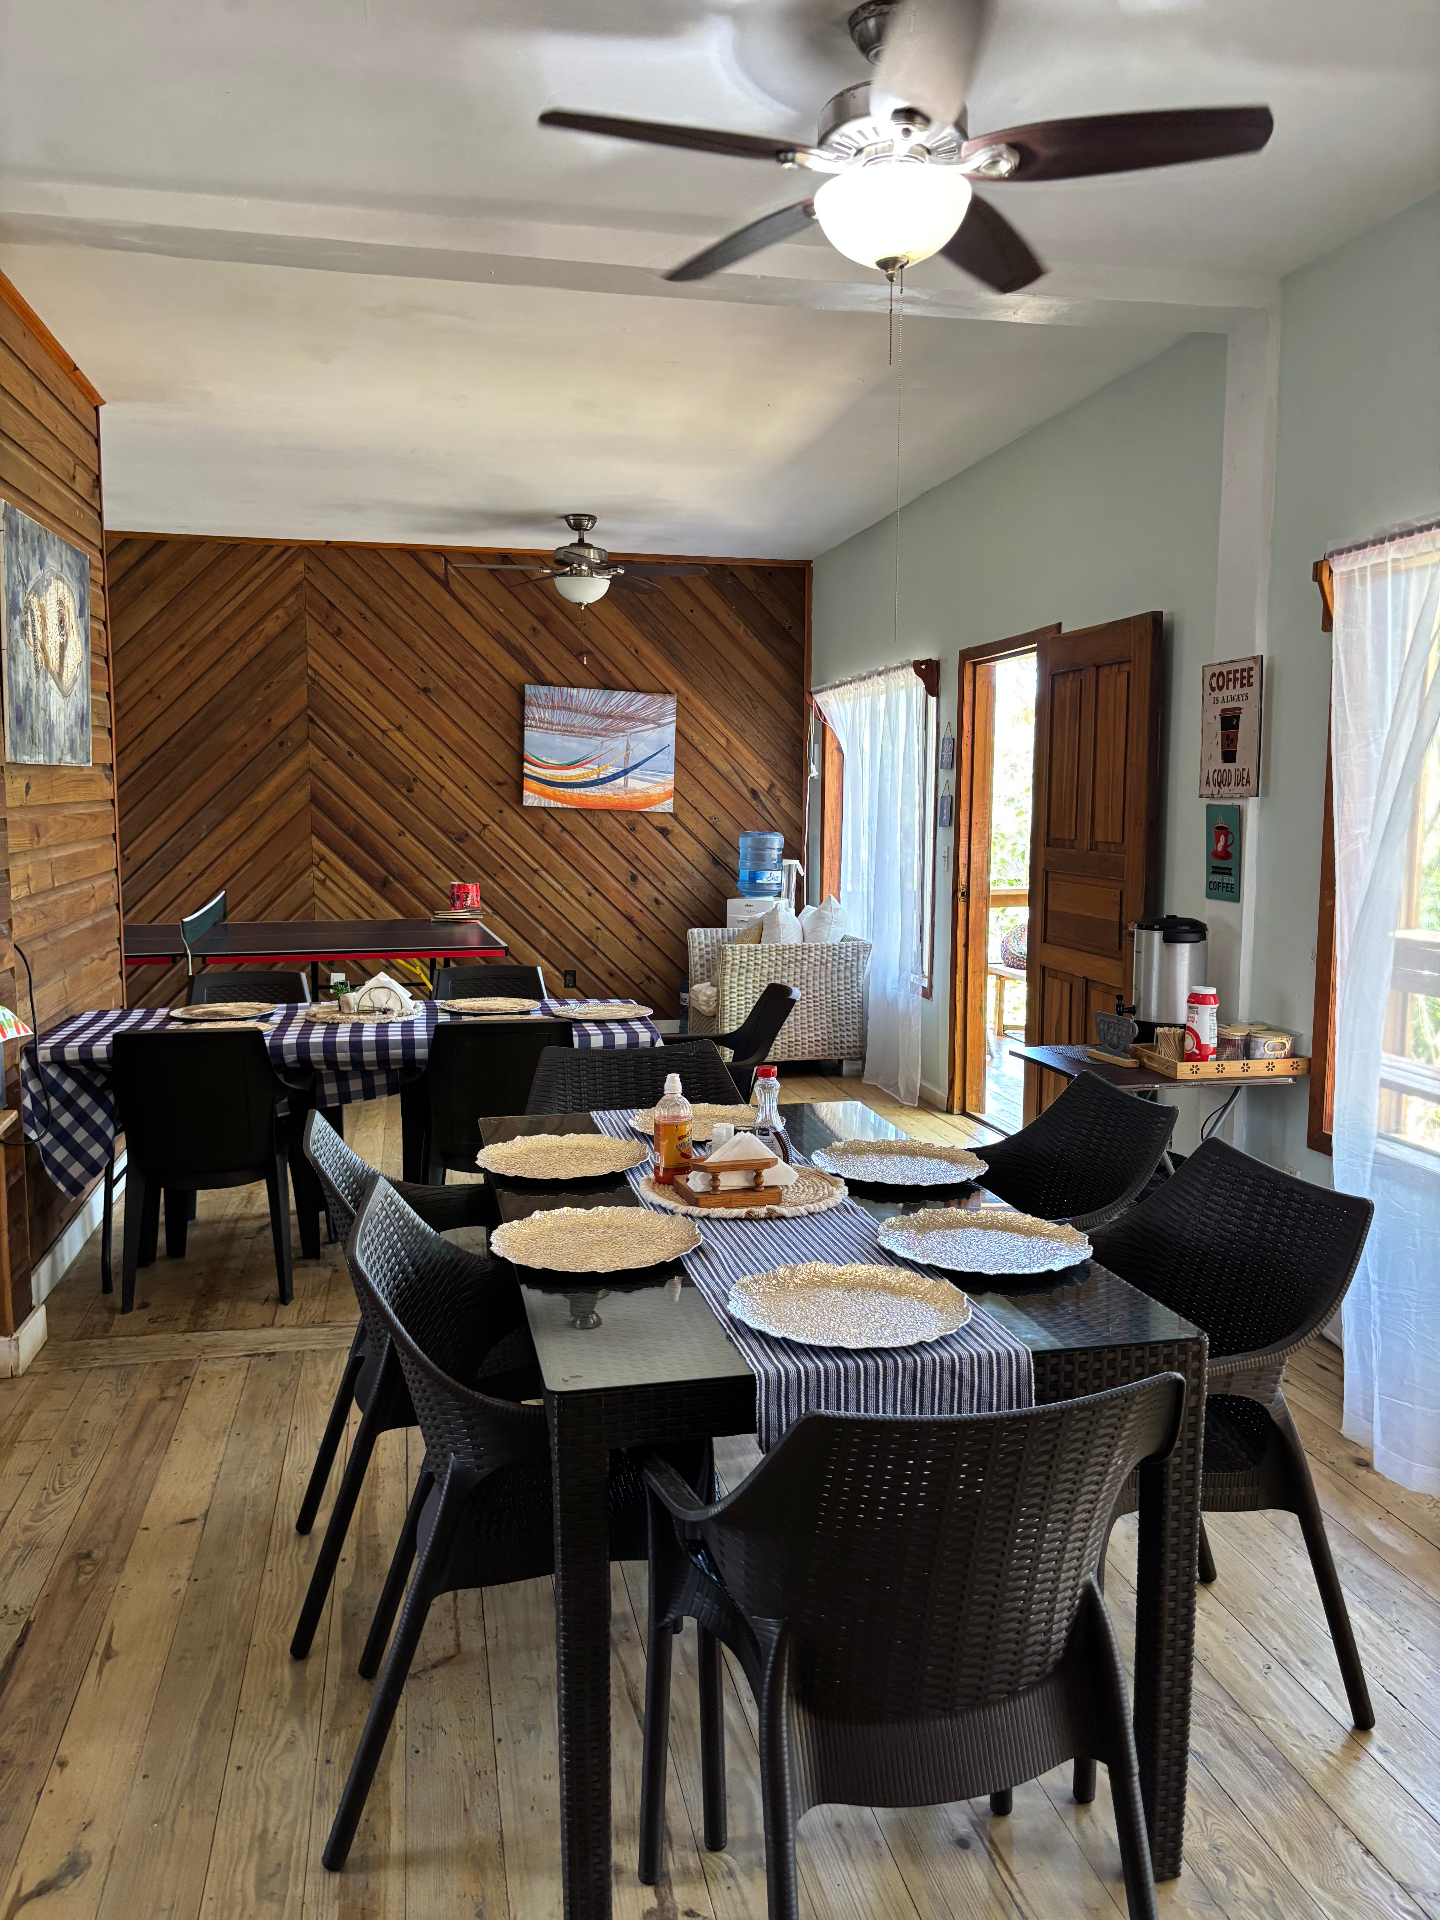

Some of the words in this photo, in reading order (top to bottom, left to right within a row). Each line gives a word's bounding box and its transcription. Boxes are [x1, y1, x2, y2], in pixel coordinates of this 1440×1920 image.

[1209, 668, 1254, 692] COFFEE
[1212, 696, 1220, 705] IS
[1221, 693, 1249, 704] ALWAYS
[1205, 769, 1211, 788] A
[1212, 769, 1232, 789] GOOD
[1233, 768, 1251, 788] IDEA
[1209, 881, 1234, 893] COFFEE
